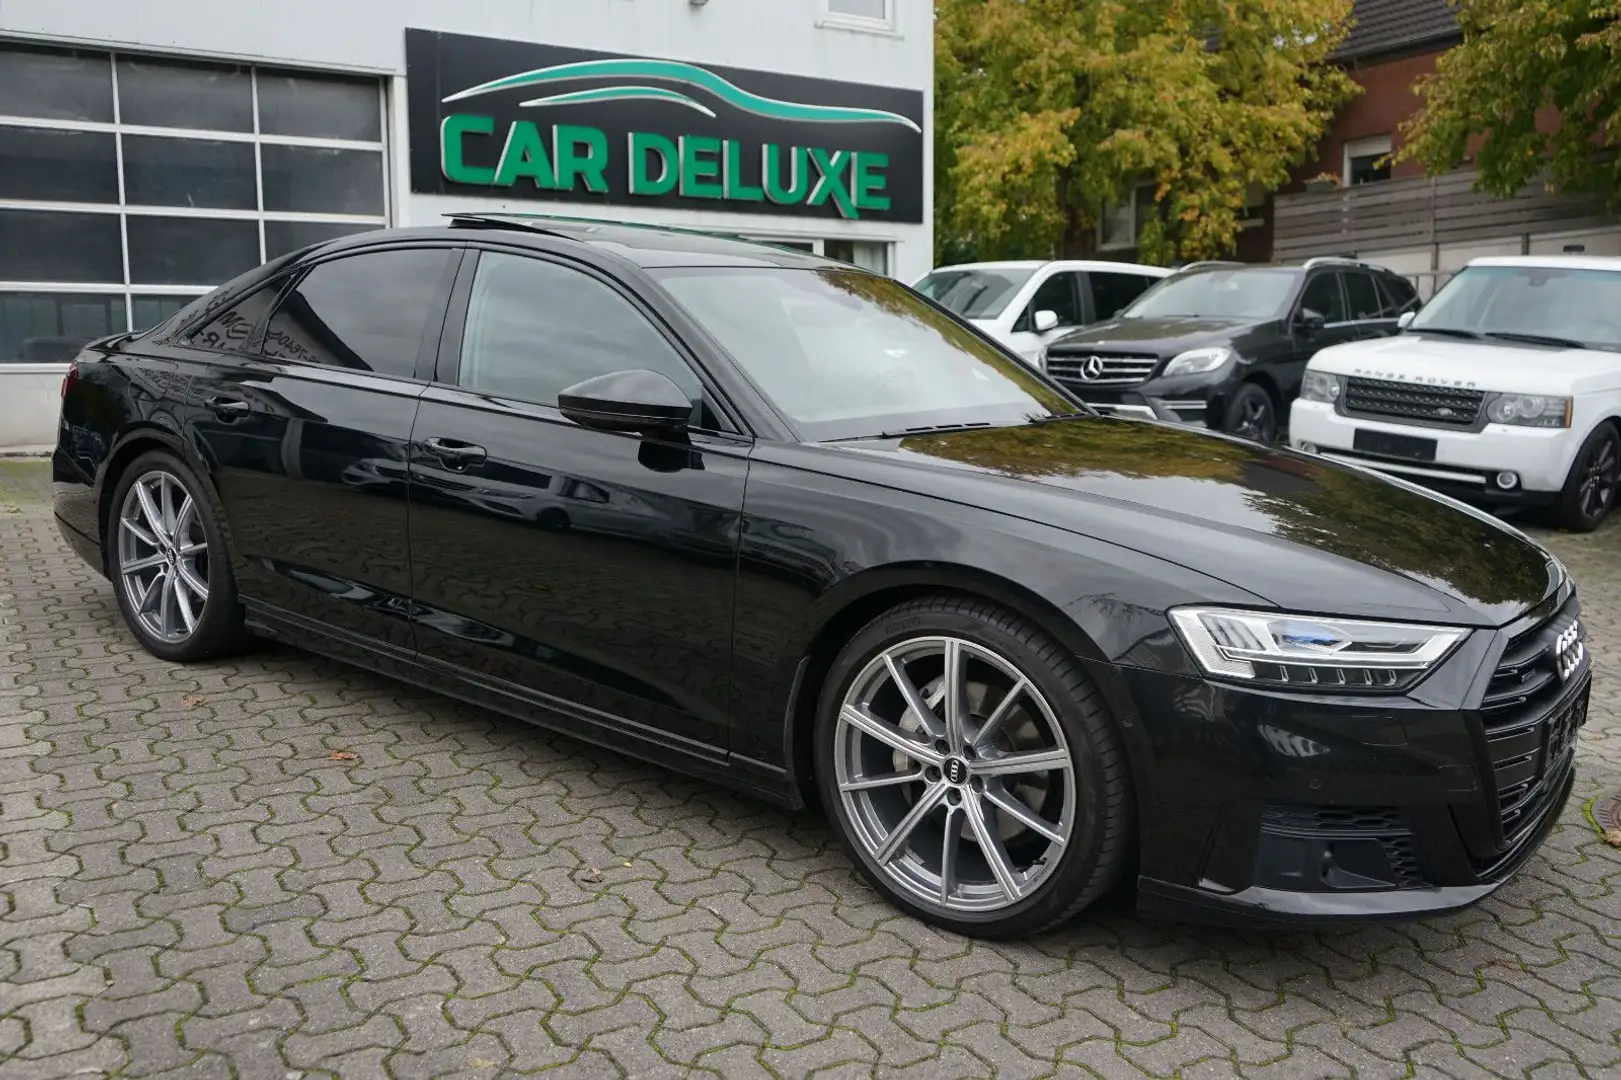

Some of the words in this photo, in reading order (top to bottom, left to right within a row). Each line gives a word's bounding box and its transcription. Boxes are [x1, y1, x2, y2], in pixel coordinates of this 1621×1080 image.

[441, 113, 609, 193] CAR
[628, 131, 891, 219] DELUXE
[1354, 368, 1405, 379] RANGE
[1415, 376, 1476, 387] ROVER
